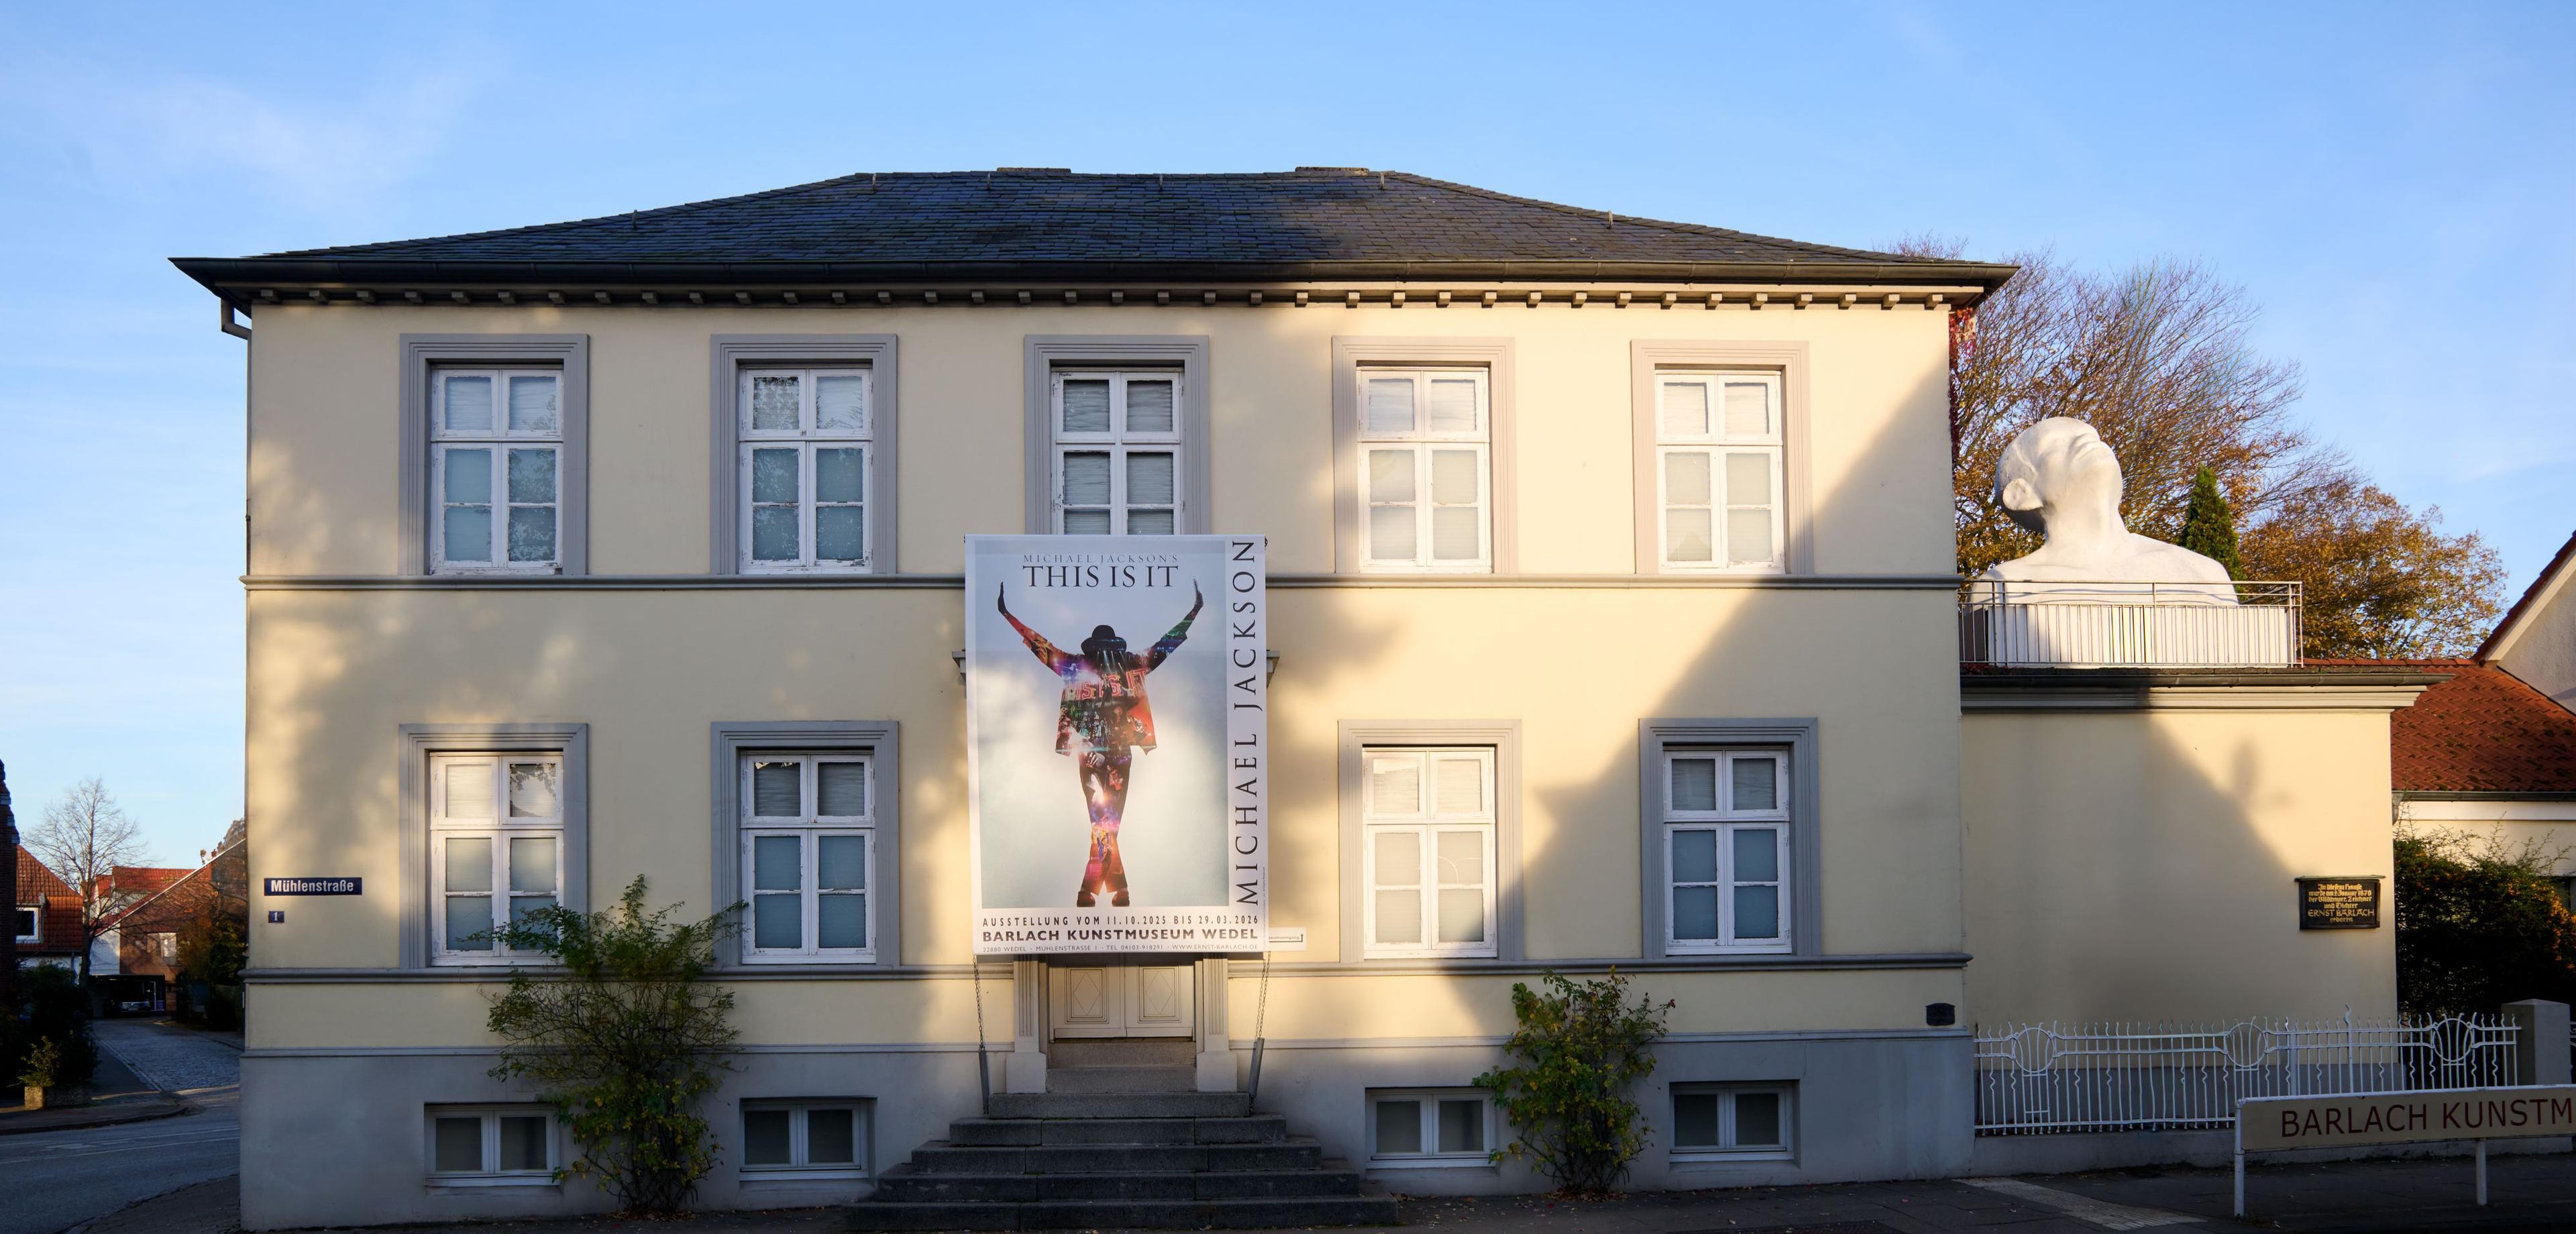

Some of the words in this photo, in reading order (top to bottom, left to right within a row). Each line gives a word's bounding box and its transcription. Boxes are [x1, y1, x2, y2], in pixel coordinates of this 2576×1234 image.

[1023, 554, 1092, 563] MICHAEL
[1099, 554, 1178, 564] JACKSON'S
[1022, 565, 1099, 587] THIS
[1109, 565, 1135, 587] IS
[1145, 565, 1179, 587] IT
[1232, 540, 1263, 713] JACKSON
[1234, 734, 1258, 905] MICHAEL
[270, 880, 354, 893] Mühlenstraße
[274, 912, 278, 921] 1
[2336, 909, 2375, 917] BARLACH
[983, 916, 1068, 927] AUSSTELLUNG
[1077, 916, 1100, 925] VOM
[1107, 915, 1166, 925] 11.10.2025
[1174, 915, 1192, 924] BIS
[1199, 915, 1258, 924] 29.03.2026
[983, 930, 1059, 942] BARLACH
[1067, 929, 1194, 941] KUNSTMUSEUM
[1202, 929, 1258, 940] WEDEL
[2282, 1104, 2427, 1138] BARLACH
[2443, 1098, 2573, 1129] KUNSTM
